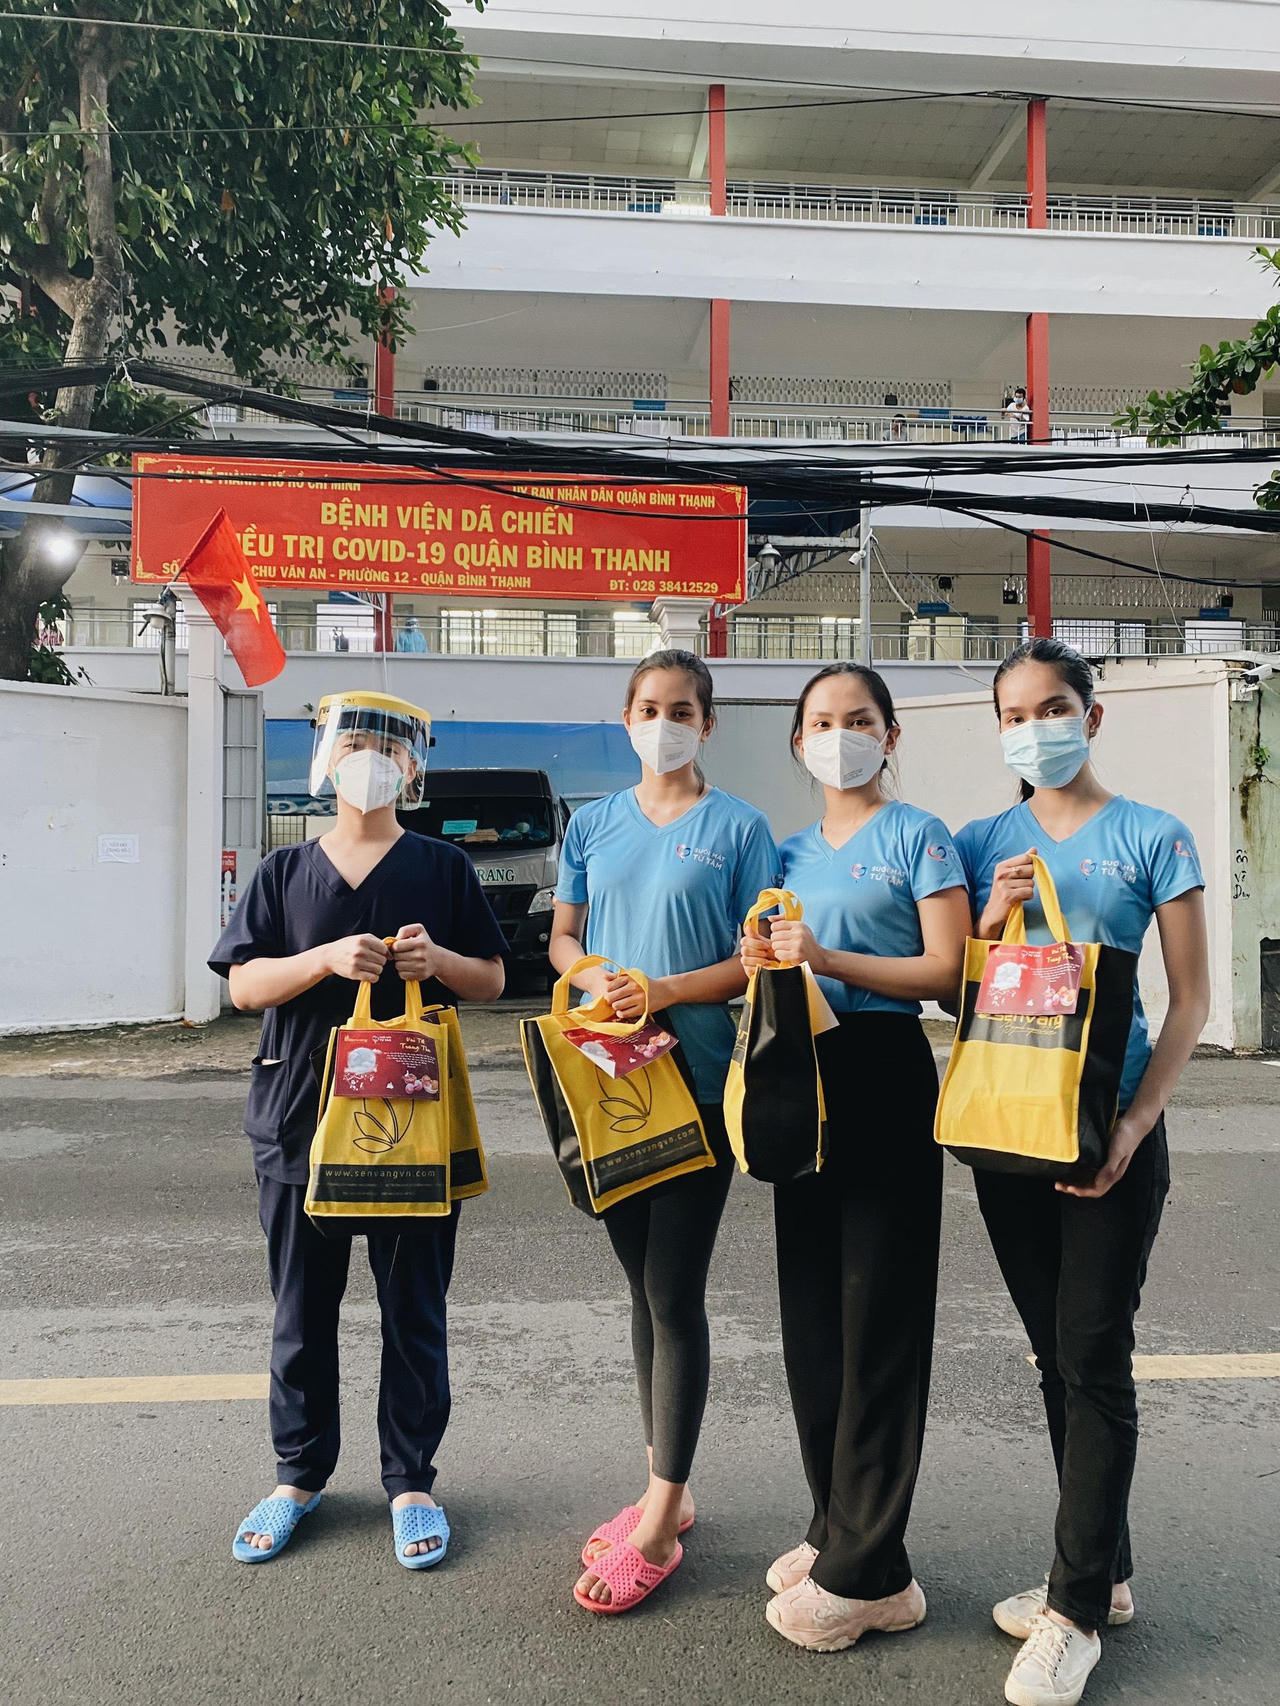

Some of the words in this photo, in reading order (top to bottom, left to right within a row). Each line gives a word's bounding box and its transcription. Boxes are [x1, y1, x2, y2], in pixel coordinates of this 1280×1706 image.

[531, 486, 554, 501] BAN
[557, 485, 588, 502] NHÂN
[591, 486, 614, 503] DÂN
[616, 488, 647, 507] QUẬN
[649, 489, 676, 506] BÌNH
[678, 494, 716, 510] THẠNH
[321, 497, 388, 531] BỆNH
[396, 501, 453, 534] VIỆN
[461, 504, 495, 533] DÃ
[501, 505, 573, 536] CHIẾN
[283, 534, 324, 564] TRỊ
[332, 537, 446, 565] COVID-19
[453, 540, 518, 573] QUẬN
[526, 541, 583, 570] BÌNH
[591, 547, 671, 576] THẠNH
[251, 565, 277, 578] CHU
[280, 563, 306, 580] VĂN
[309, 566, 327, 580] AN
[338, 567, 390, 583] PHƯỜNG
[394, 571, 409, 584] 12
[420, 570, 454, 587] QUẬN
[457, 571, 487, 587] BÌNH
[490, 575, 531, 590] THẠNH
[610, 579, 629, 592] ĐT:
[632, 580, 656, 593] 028
[659, 581, 719, 595] 38412529
[477, 867, 515, 882] RANG
